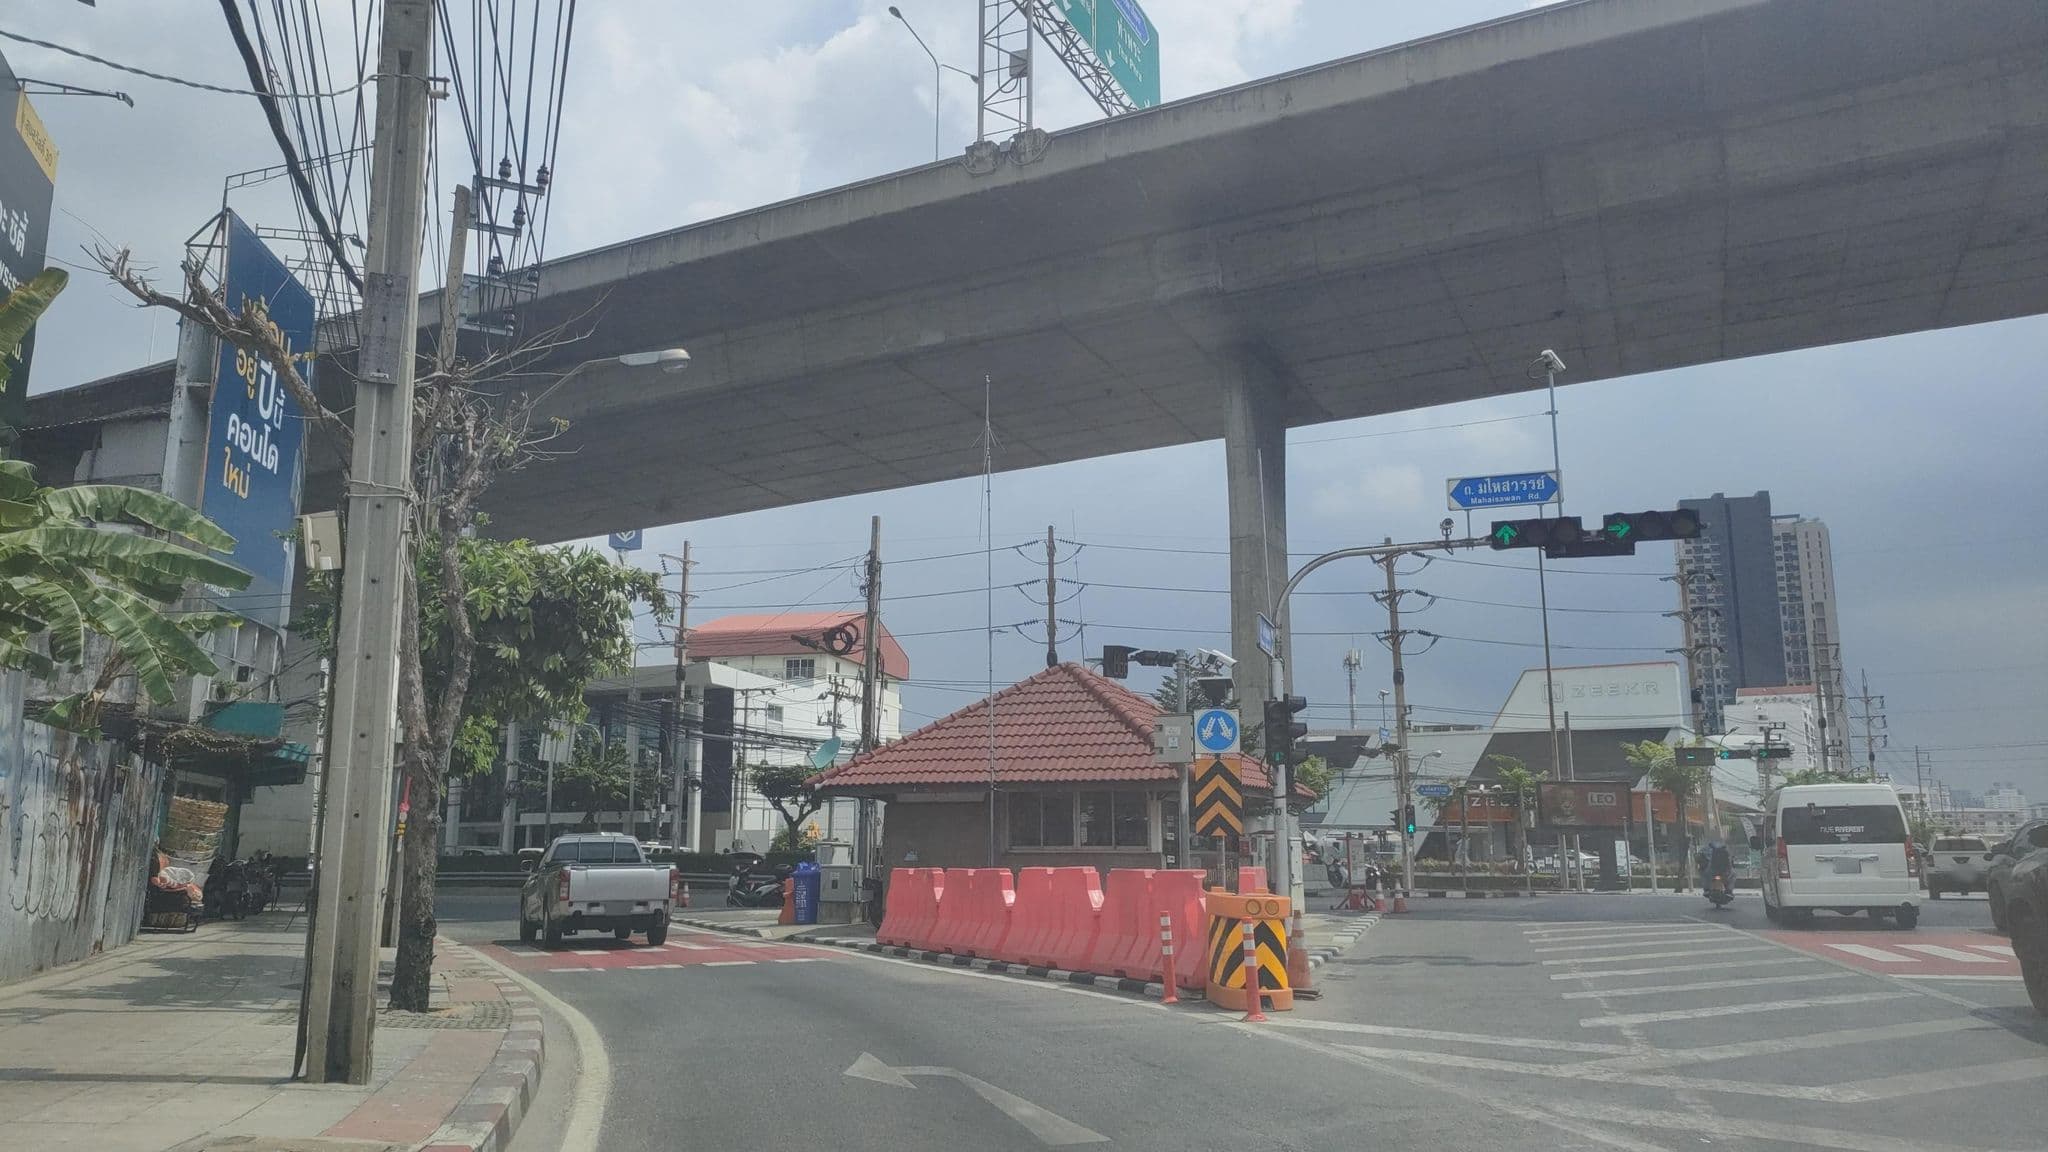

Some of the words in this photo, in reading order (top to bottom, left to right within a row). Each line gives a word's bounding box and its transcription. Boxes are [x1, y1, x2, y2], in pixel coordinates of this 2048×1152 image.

[227, 413, 279, 475] คอนโด
[223, 446, 251, 499] ใหม่
[1471, 495, 1521, 504] Mahaisawan
[1570, 681, 1659, 699] ZEEKR
[1589, 793, 1615, 804] LEO
